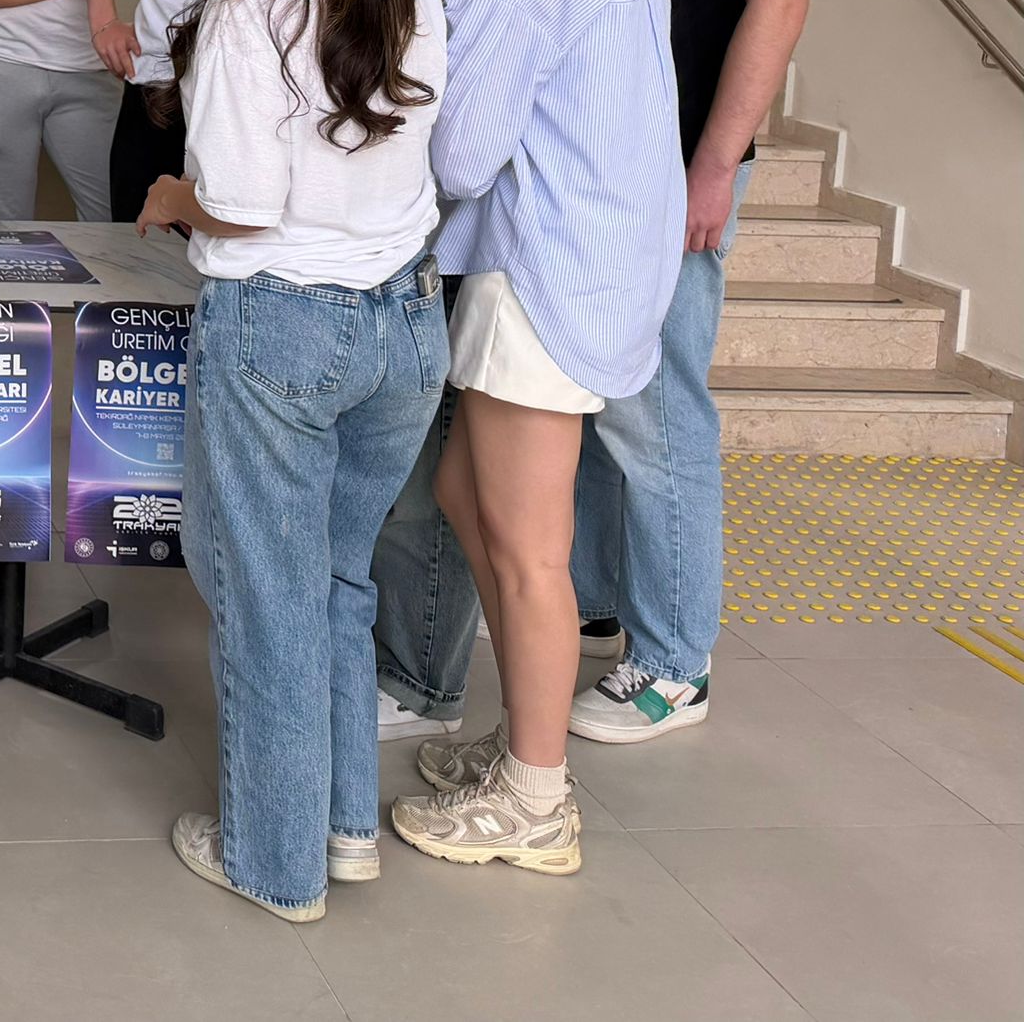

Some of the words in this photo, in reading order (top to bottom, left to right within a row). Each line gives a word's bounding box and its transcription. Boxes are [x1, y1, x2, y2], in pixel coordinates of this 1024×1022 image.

[110, 307, 192, 331] GENÇLİ
[112, 329, 175, 351] ÜRETİM
[98, 354, 187, 385] BÖLGE
[95, 386, 180, 407] KARİYER
[113, 520, 181, 532] TRAKYA
